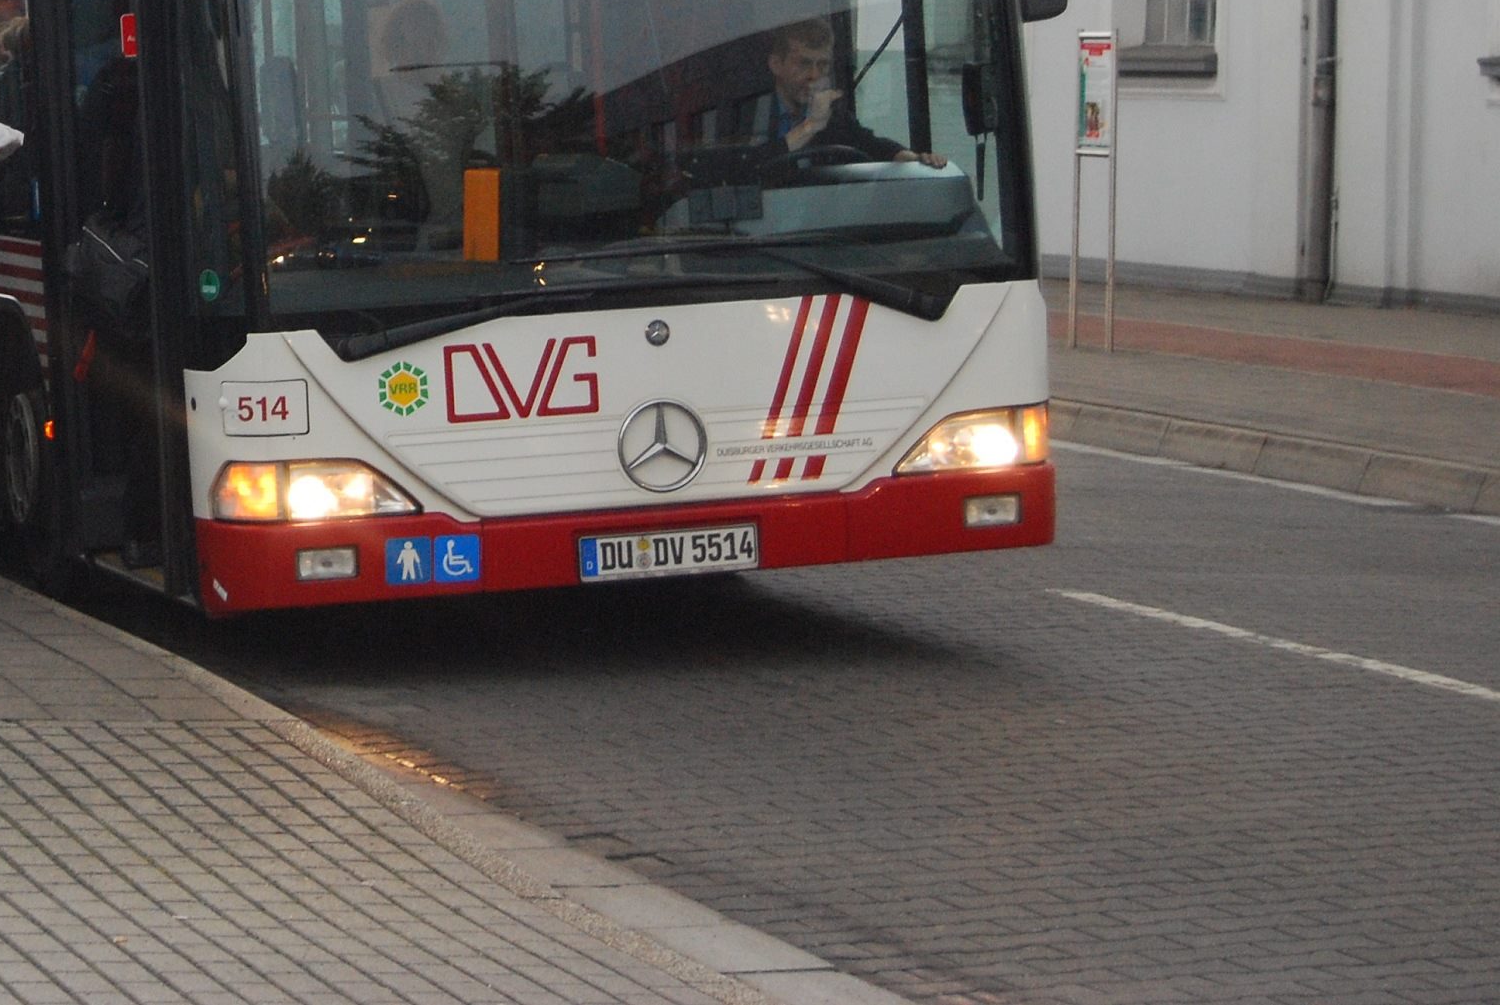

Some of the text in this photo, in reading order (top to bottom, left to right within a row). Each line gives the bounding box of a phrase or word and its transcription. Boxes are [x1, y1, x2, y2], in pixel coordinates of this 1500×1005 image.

[389, 382, 418, 395] VRR
[443, 335, 600, 424] DVG
[237, 395, 289, 422] 514
[716, 445, 765, 457] DUISBURGER
[861, 437, 873, 447] AG
[601, 531, 753, 571] DU DV 5514
